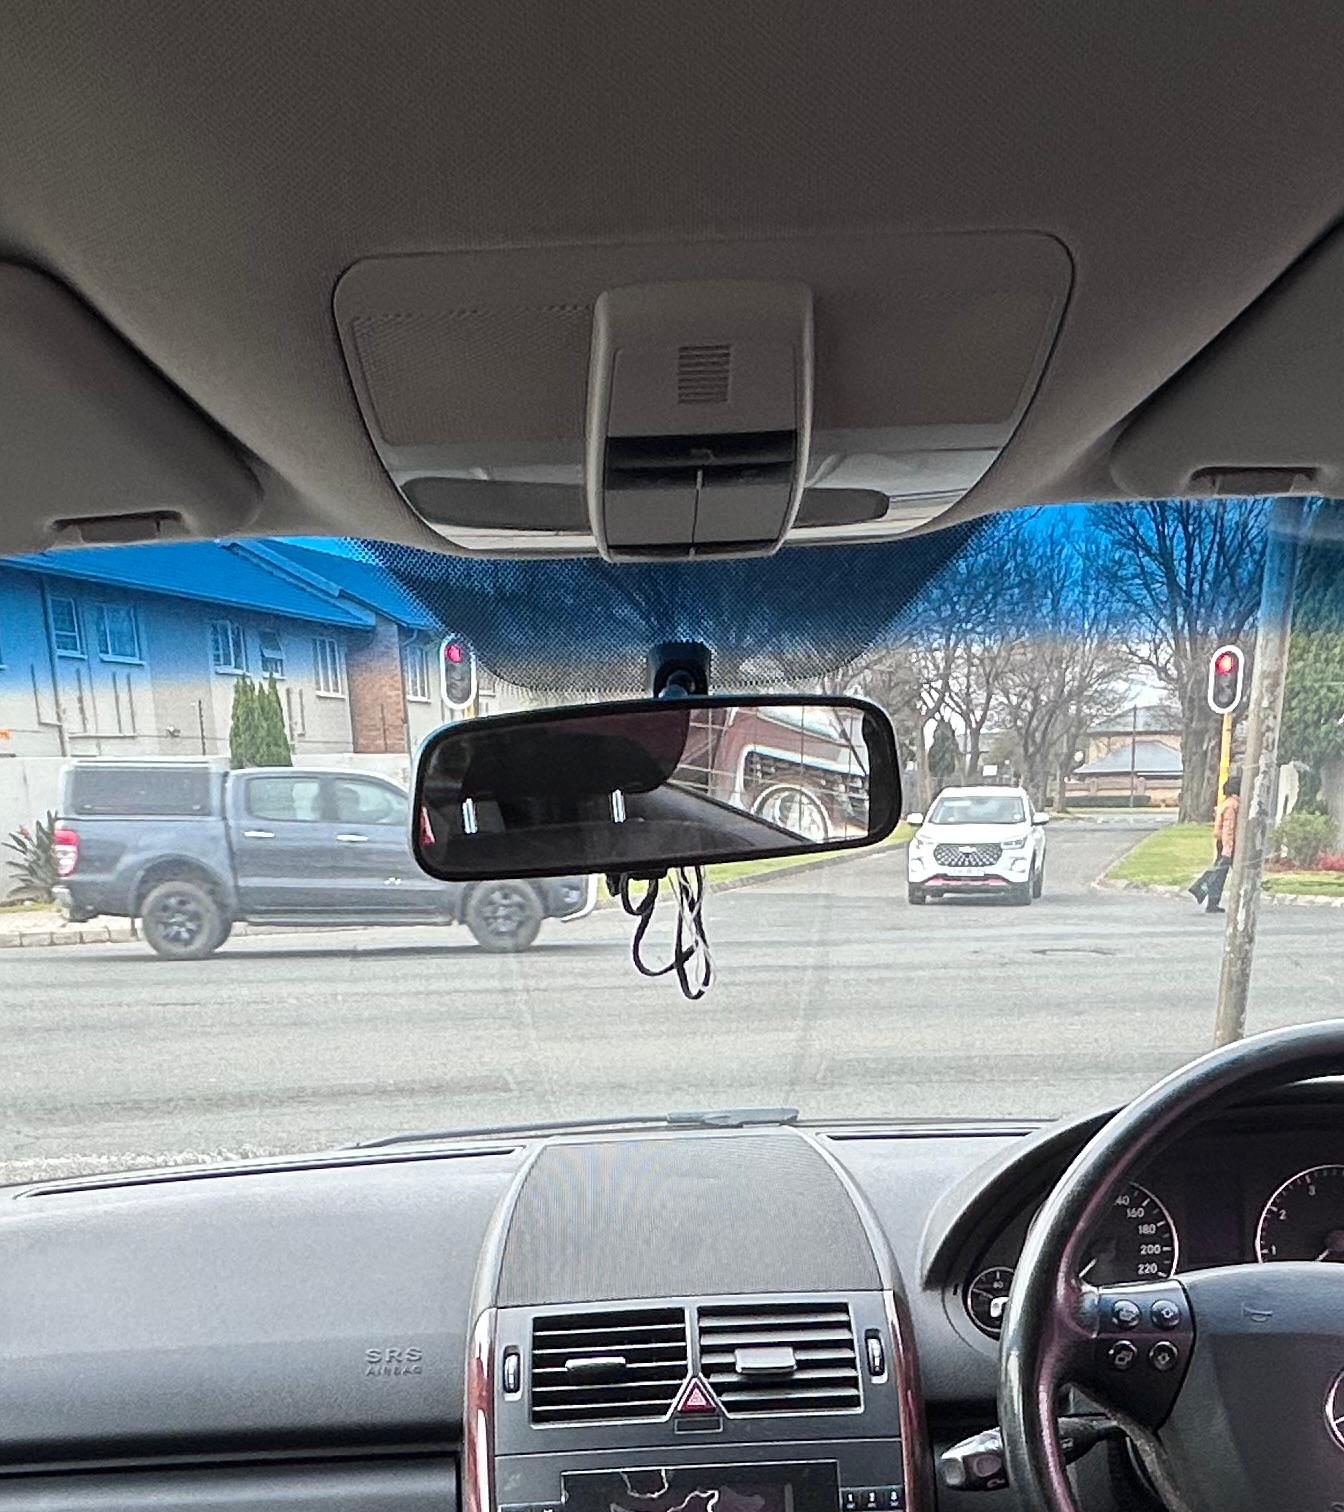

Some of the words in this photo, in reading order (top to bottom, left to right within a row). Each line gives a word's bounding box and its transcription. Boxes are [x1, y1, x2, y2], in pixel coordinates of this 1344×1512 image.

[1308, 1185, 1316, 1196] 3
[1126, 1207, 1144, 1218] 160
[1279, 1209, 1287, 1220] 2
[1138, 1223, 1156, 1235] 180
[1140, 1244, 1161, 1256] 200
[1138, 1263, 1158, 1275] 220
[364, 1346, 423, 1364] SRS
